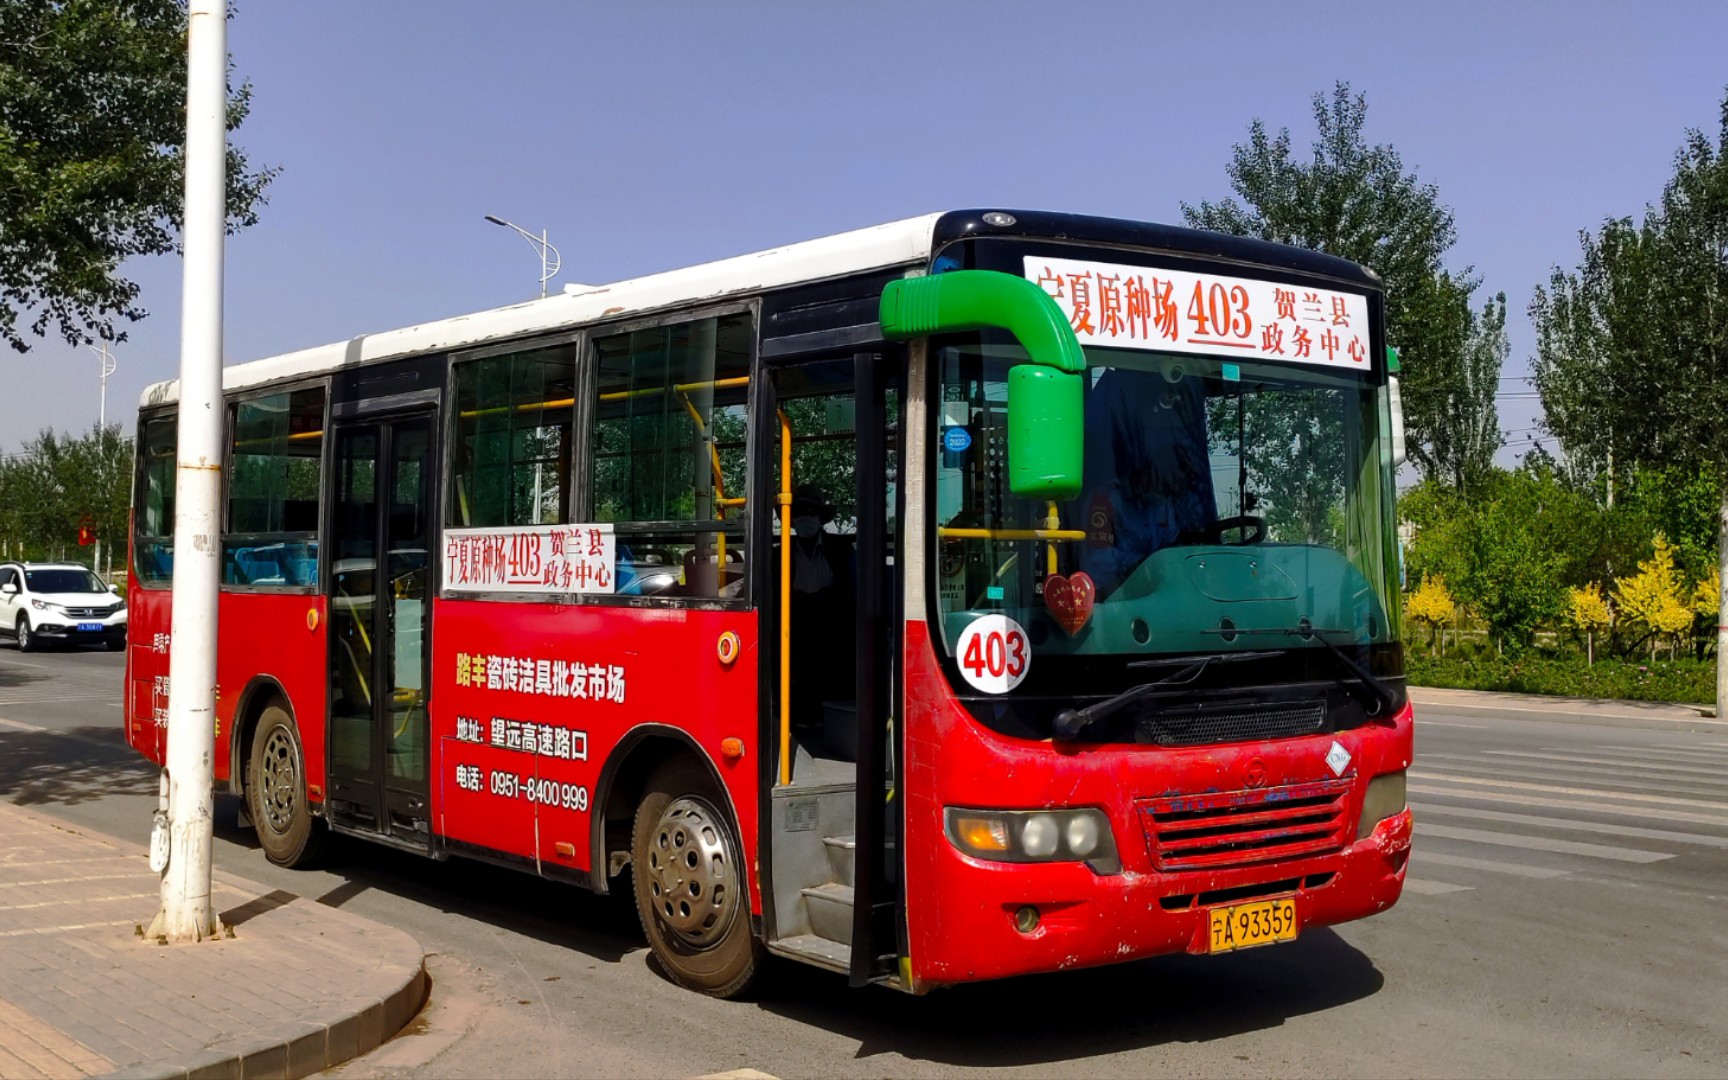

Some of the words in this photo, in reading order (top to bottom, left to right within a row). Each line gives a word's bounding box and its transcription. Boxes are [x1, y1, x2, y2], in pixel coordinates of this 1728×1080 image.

[1187, 280, 1257, 339] 403
[1272, 287, 1352, 329] 贺兰县
[1261, 323, 1367, 363] 政务中心
[447, 535, 506, 585] 宁夏原种场
[507, 532, 542, 577] 403
[550, 528, 605, 557] 贺兰县
[543, 559, 612, 588] 政务中心
[963, 630, 1026, 678] 403
[455, 652, 626, 704] 路丰瓷砖洁具批发市场
[490, 717, 588, 761] 望远高速路口
